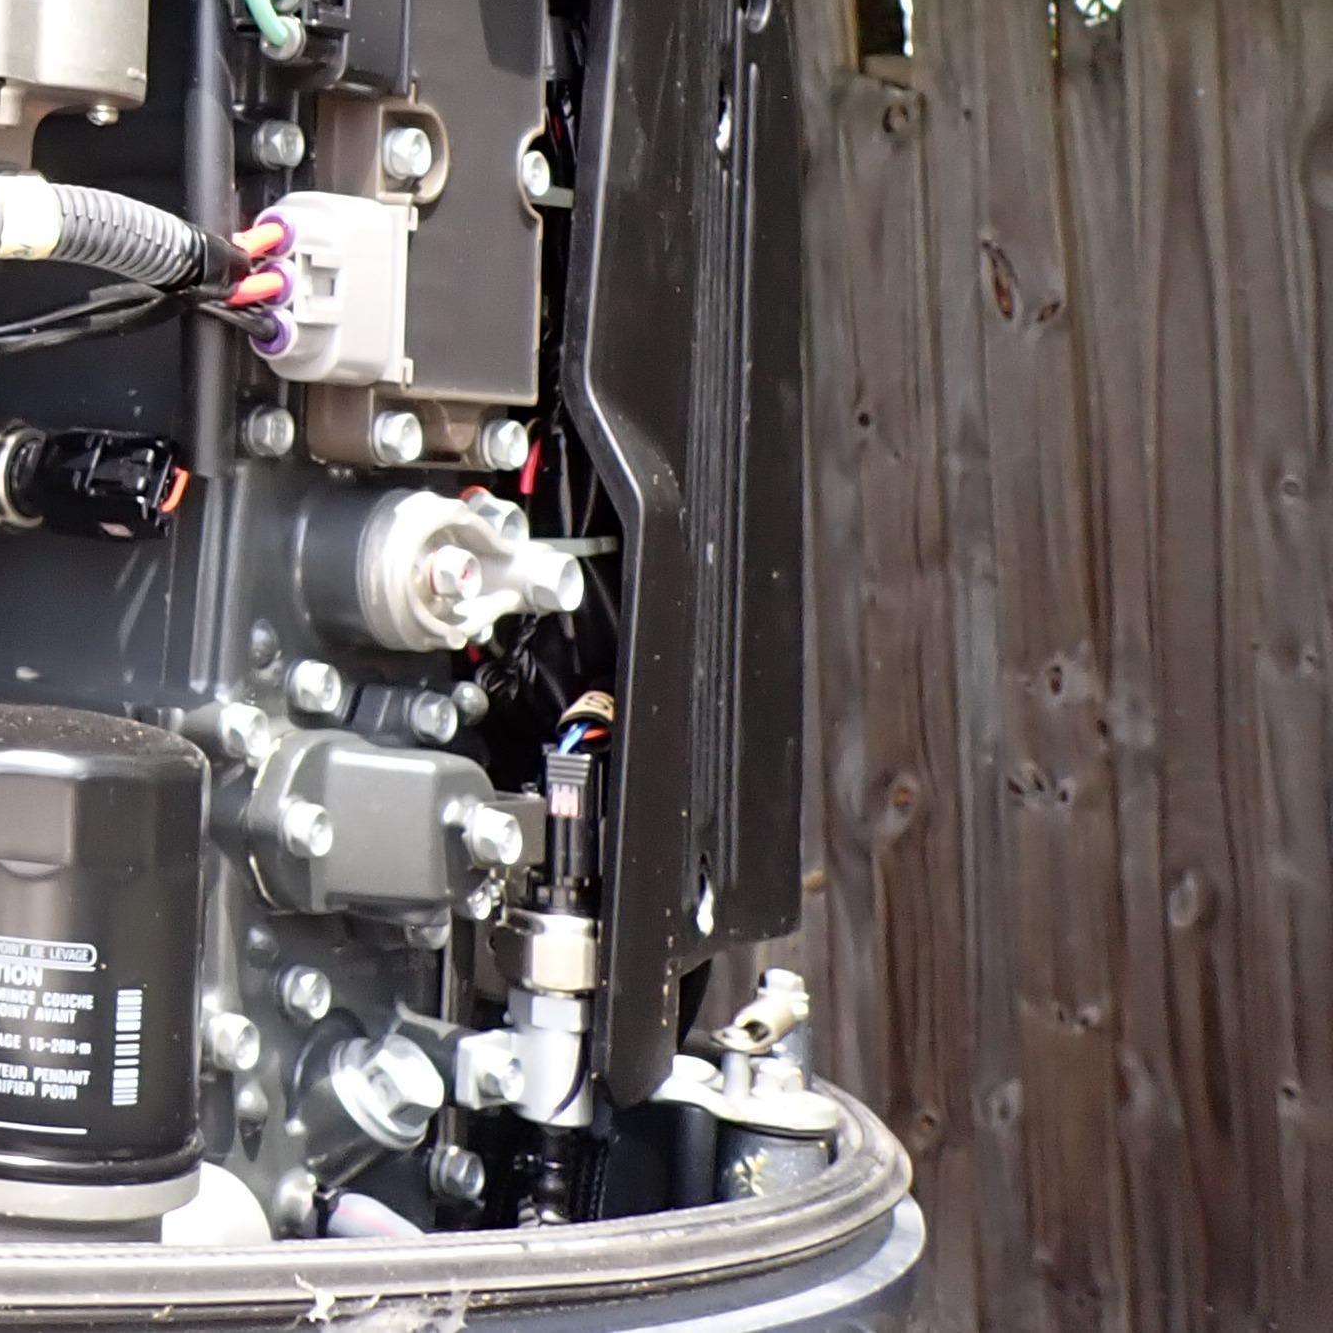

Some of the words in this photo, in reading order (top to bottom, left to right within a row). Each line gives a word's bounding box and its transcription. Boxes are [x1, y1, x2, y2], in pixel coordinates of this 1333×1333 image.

[49, 946, 89, 963] LEVAGE
[42, 992, 94, 1010] COUCHE
[34, 1006, 77, 1024] AVANT
[33, 1066, 91, 1086] PENDANT
[41, 1083, 78, 1100] POUR
